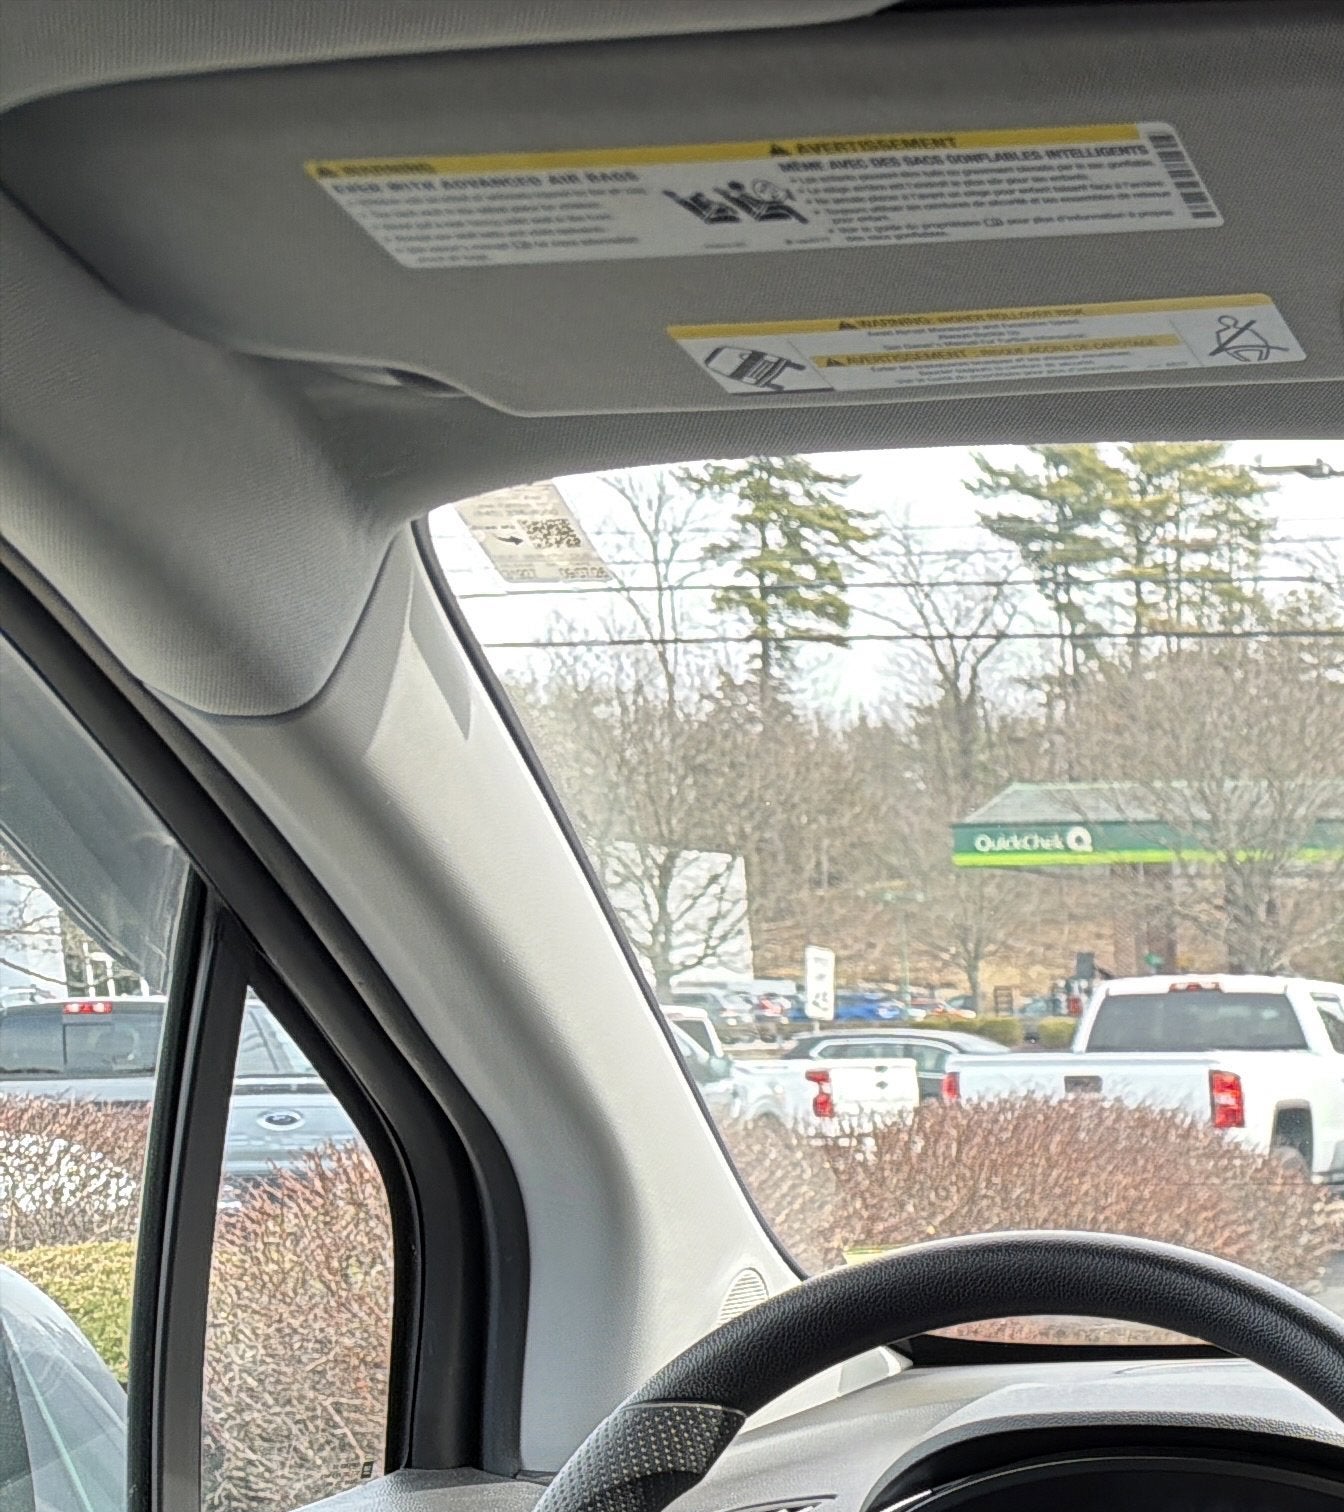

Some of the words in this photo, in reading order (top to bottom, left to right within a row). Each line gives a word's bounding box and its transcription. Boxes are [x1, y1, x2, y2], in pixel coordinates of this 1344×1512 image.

[796, 136, 957, 154] AVERTISSEMENT
[829, 157, 870, 170] AVEC
[869, 156, 901, 168] DES
[902, 154, 945, 167] SACS
[1044, 144, 1150, 159] INTELLIGENTS
